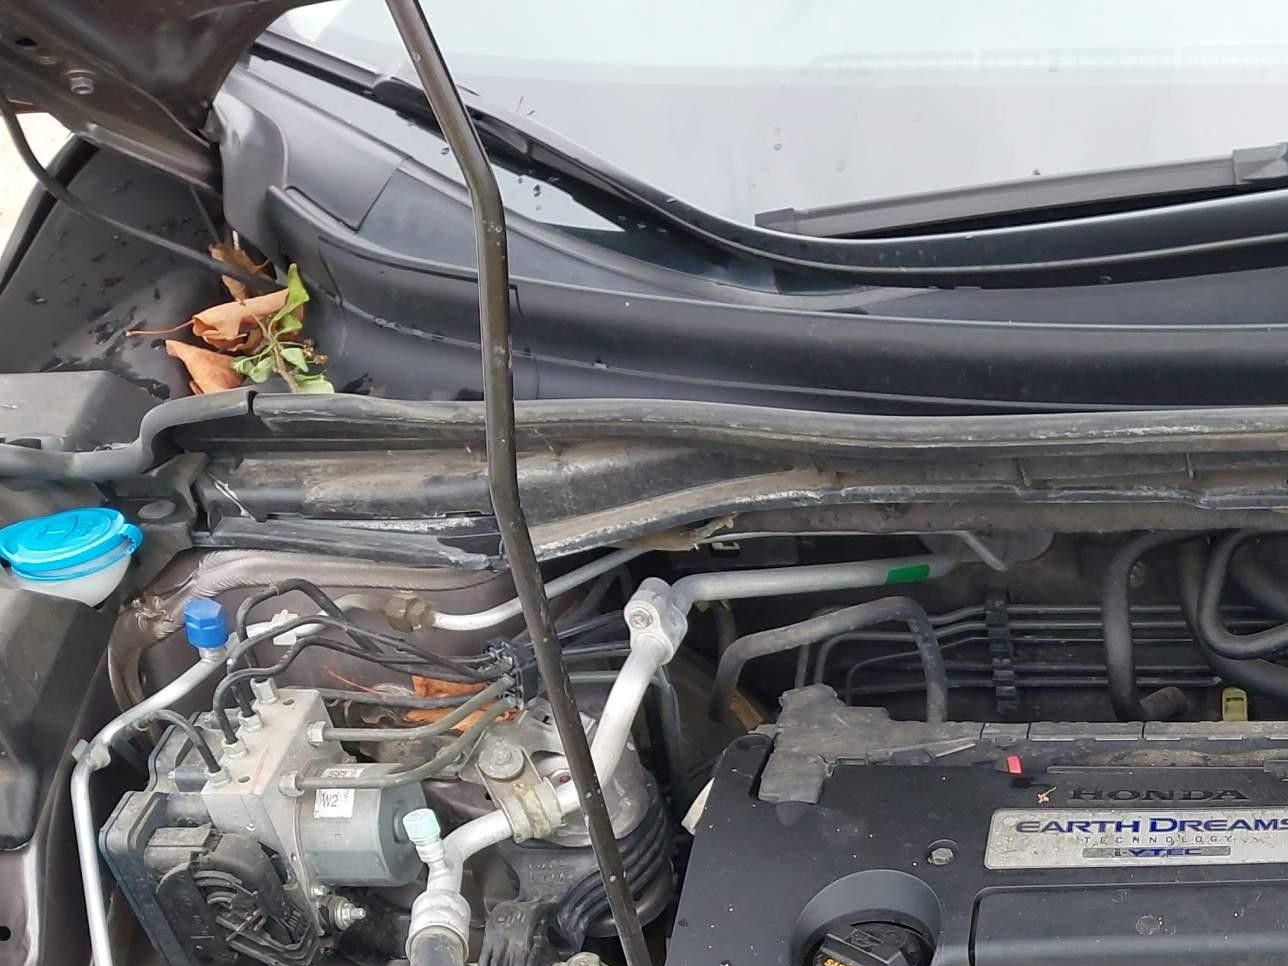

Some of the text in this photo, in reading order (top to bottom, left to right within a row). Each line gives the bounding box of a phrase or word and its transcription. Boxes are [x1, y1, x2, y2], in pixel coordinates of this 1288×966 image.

[1069, 788, 1249, 801] HONDA
[1015, 819, 1140, 834] EARTH
[1083, 835, 1234, 845] TECHNOLOGY
